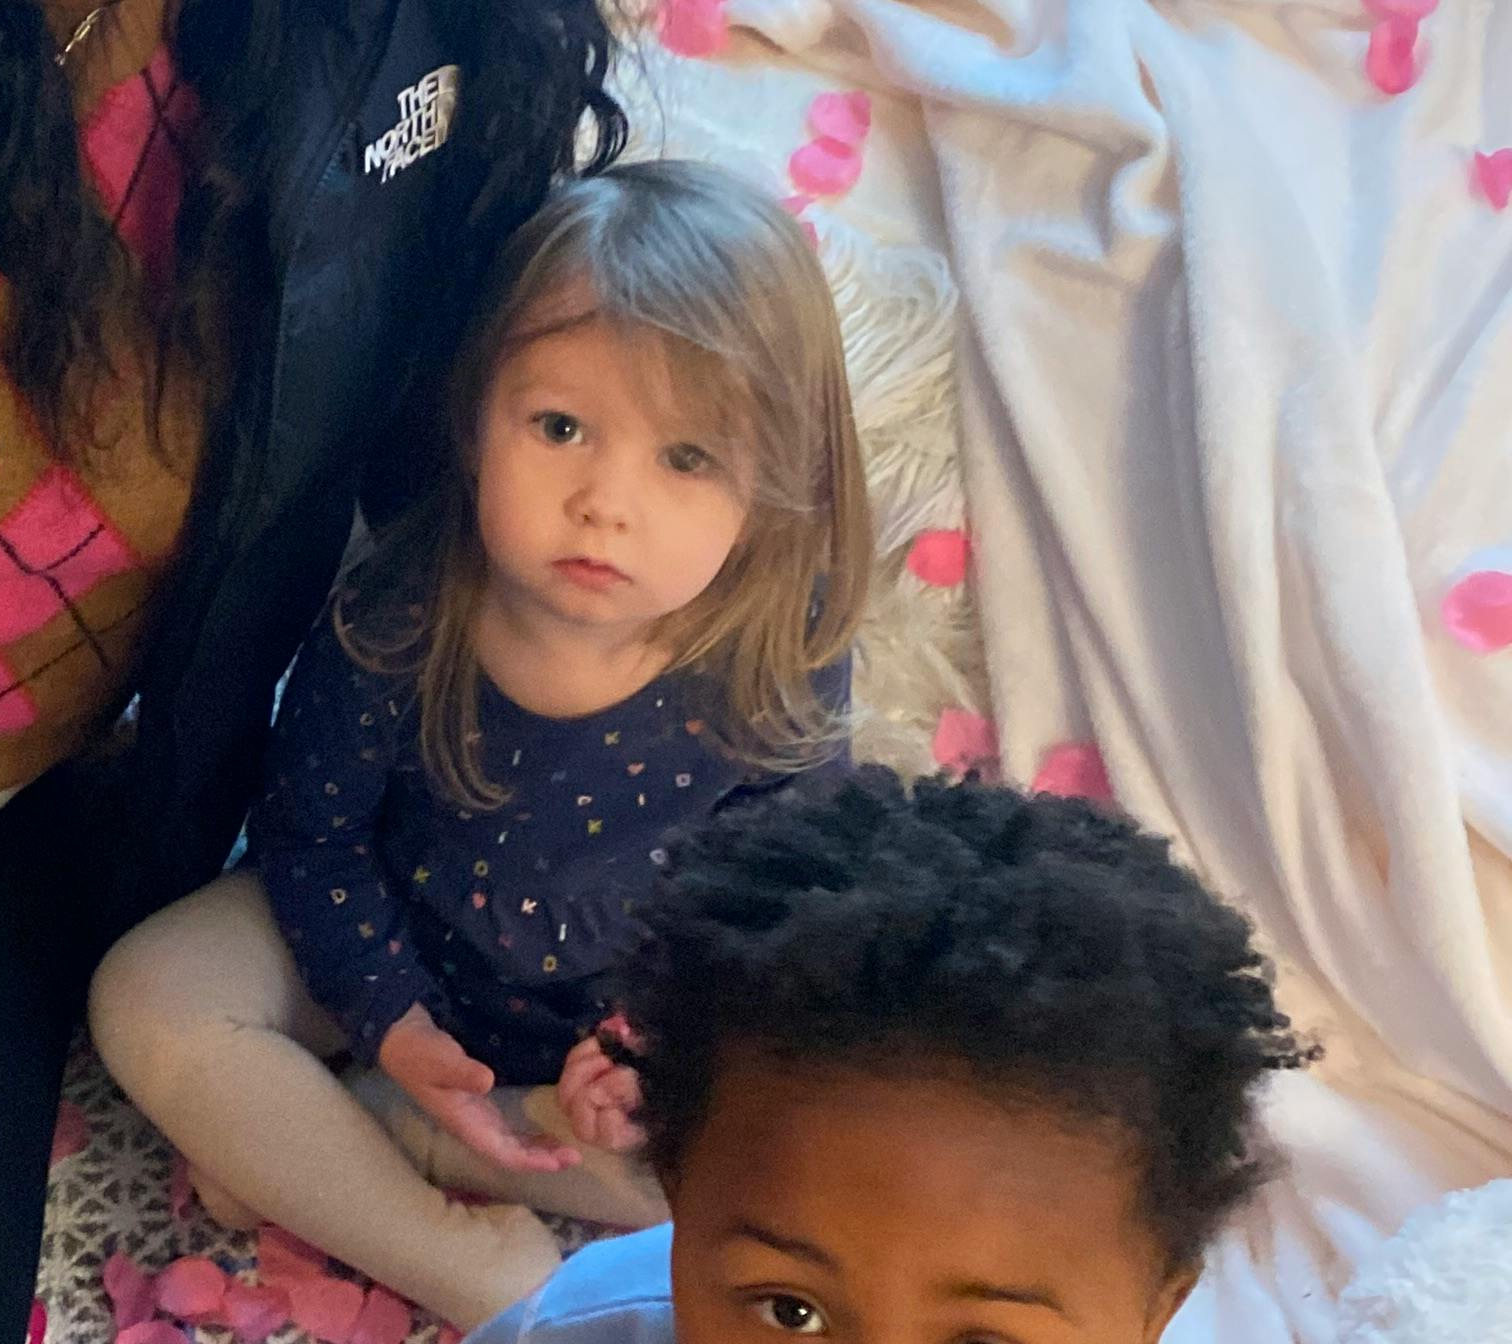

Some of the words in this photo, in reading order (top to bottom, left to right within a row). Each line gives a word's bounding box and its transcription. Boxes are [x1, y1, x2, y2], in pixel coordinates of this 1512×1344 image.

[396, 75, 439, 120] THE
[365, 97, 438, 174] NORTH
[381, 127, 436, 184] FACE
